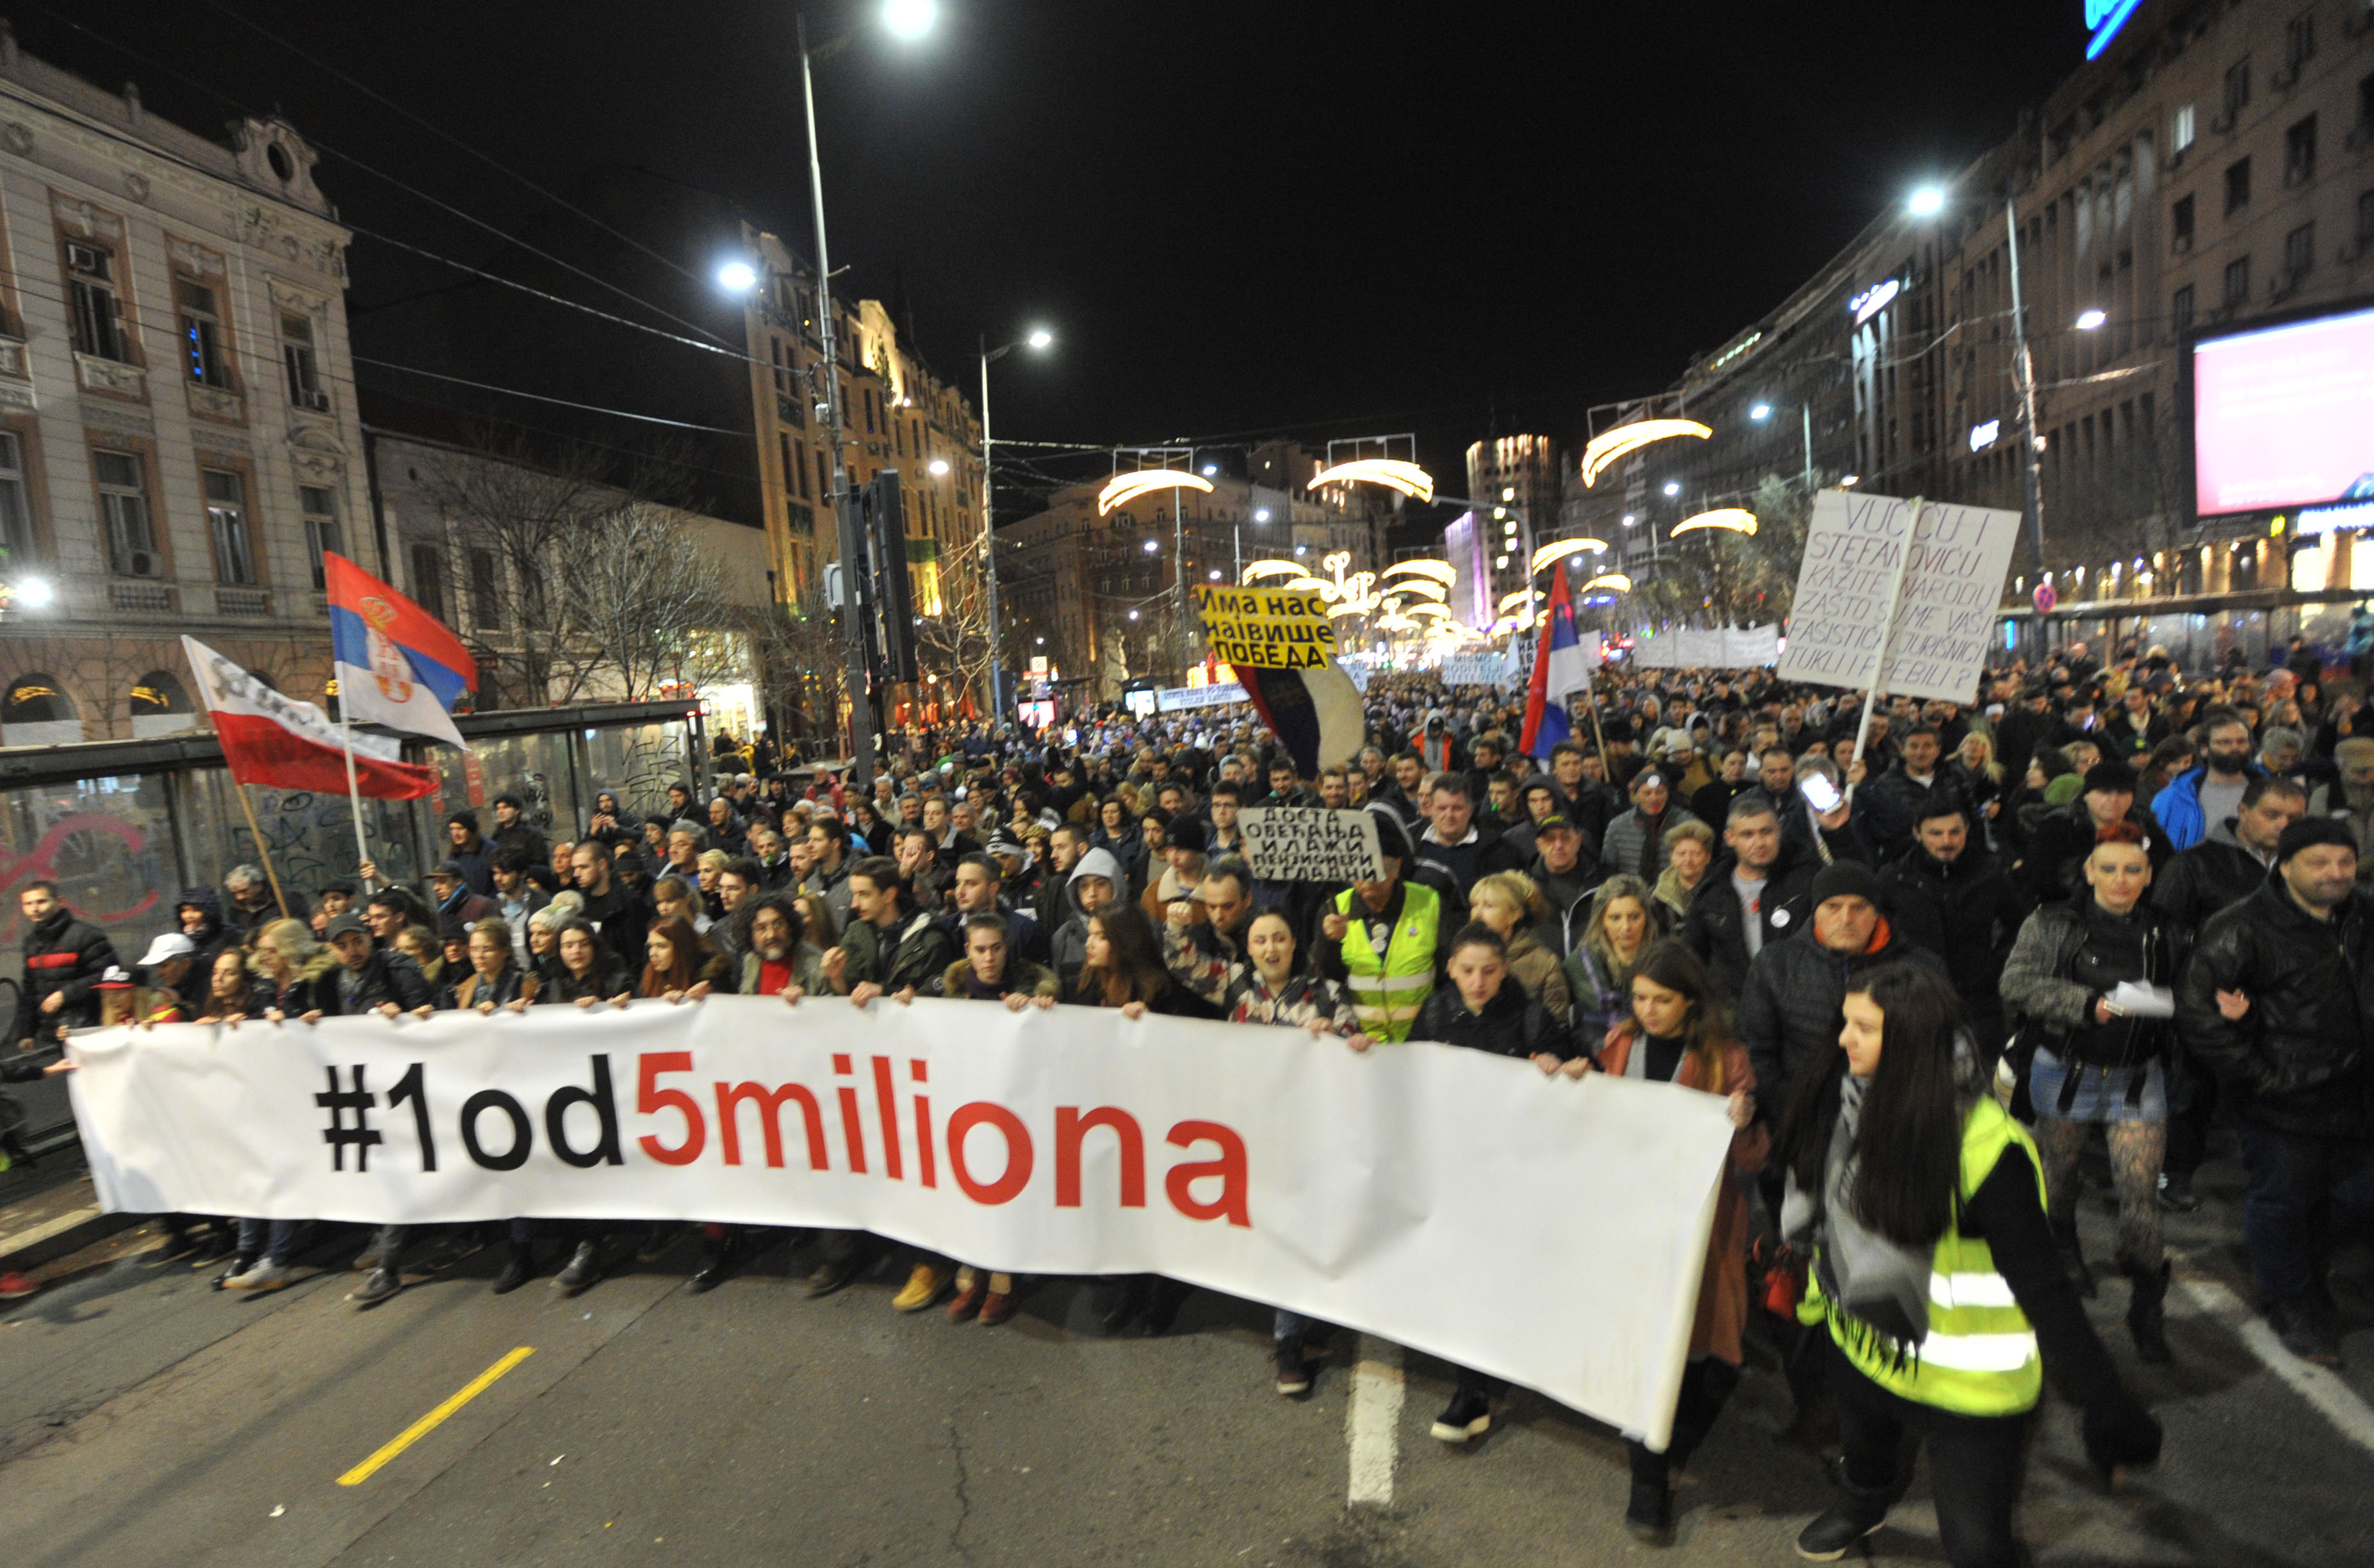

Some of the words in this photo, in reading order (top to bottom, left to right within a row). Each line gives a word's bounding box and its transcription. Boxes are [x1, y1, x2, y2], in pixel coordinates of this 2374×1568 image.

[1846, 495, 1965, 543] VUČĆU
[1975, 510, 1990, 546] I
[1900, 575, 1997, 609] NARODU
[1905, 604, 1944, 630] ME
[1787, 646, 1846, 674] TUKLI
[1846, 654, 1859, 676] I
[313, 1050, 1254, 1230] #1od5miliona
